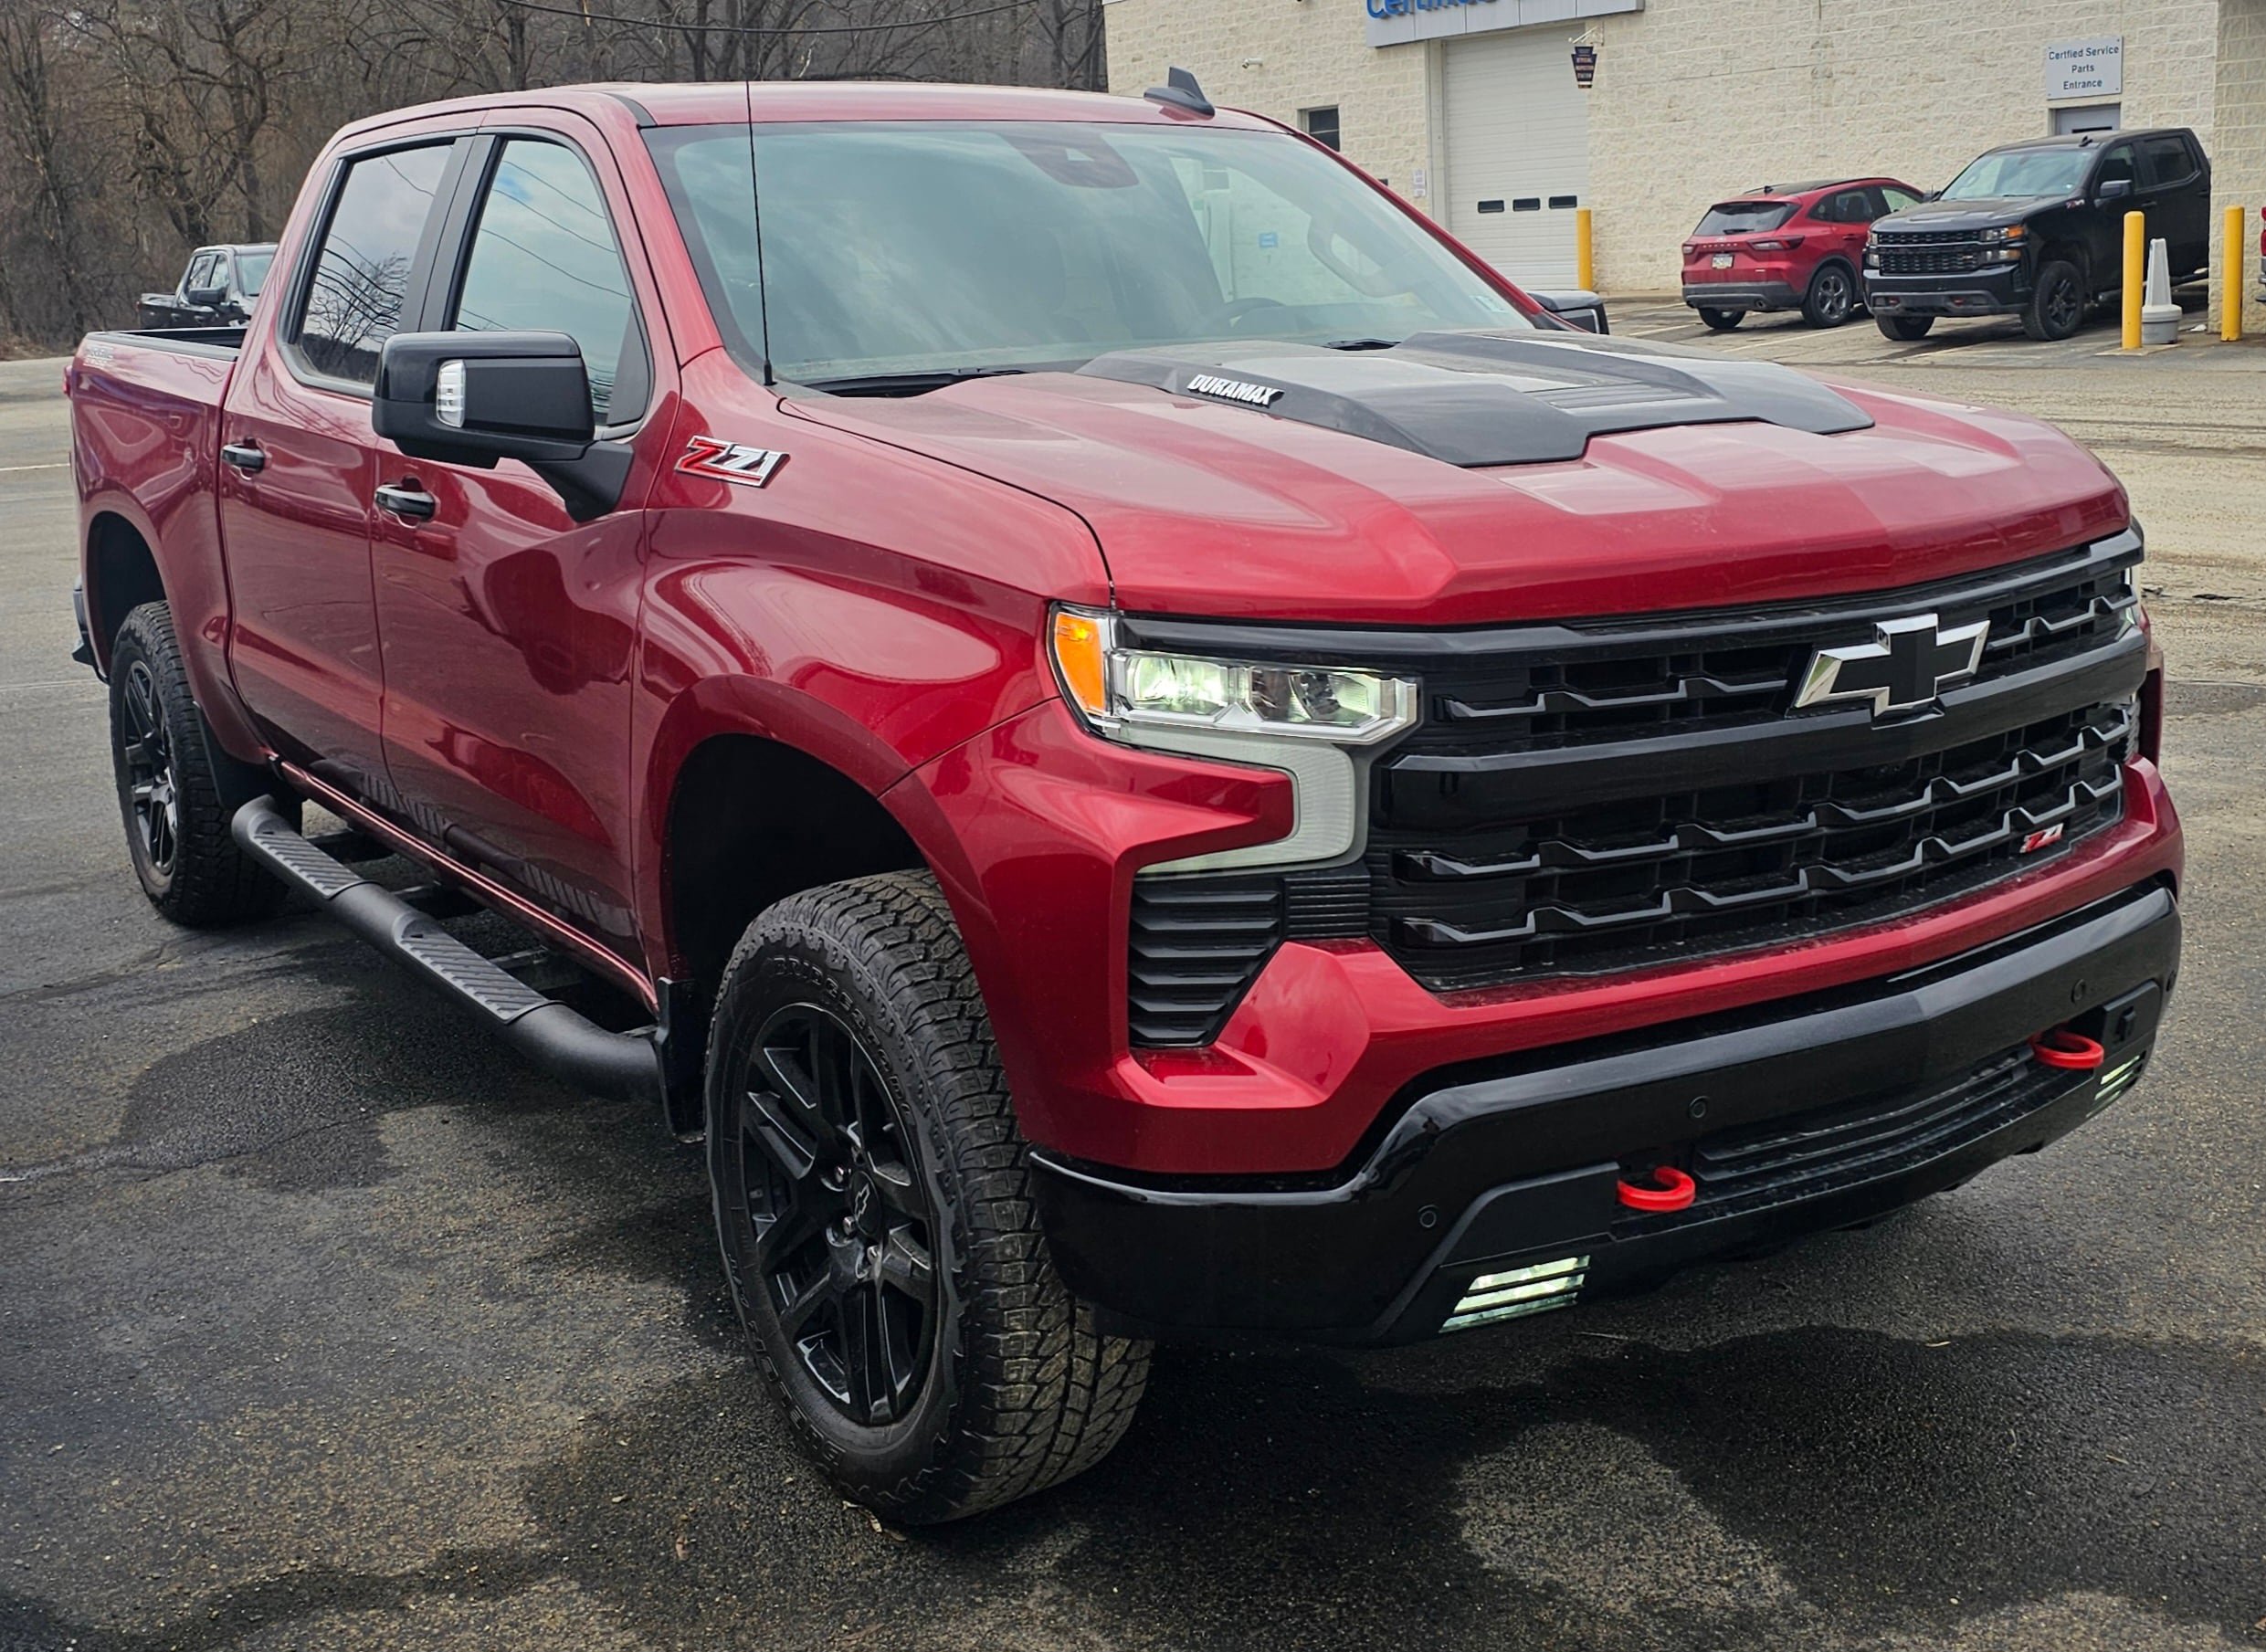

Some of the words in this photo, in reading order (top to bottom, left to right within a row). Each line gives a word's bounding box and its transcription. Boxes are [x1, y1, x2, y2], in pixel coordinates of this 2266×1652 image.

[2049, 49, 2083, 60] Certified
[2085, 47, 2119, 57] Service
[2071, 65, 2094, 73] Parts
[2063, 79, 2103, 89] Entrance
[1186, 374, 1285, 407] DURAMAX
[674, 434, 789, 488] Z71
[2020, 823, 2063, 853] Z71
